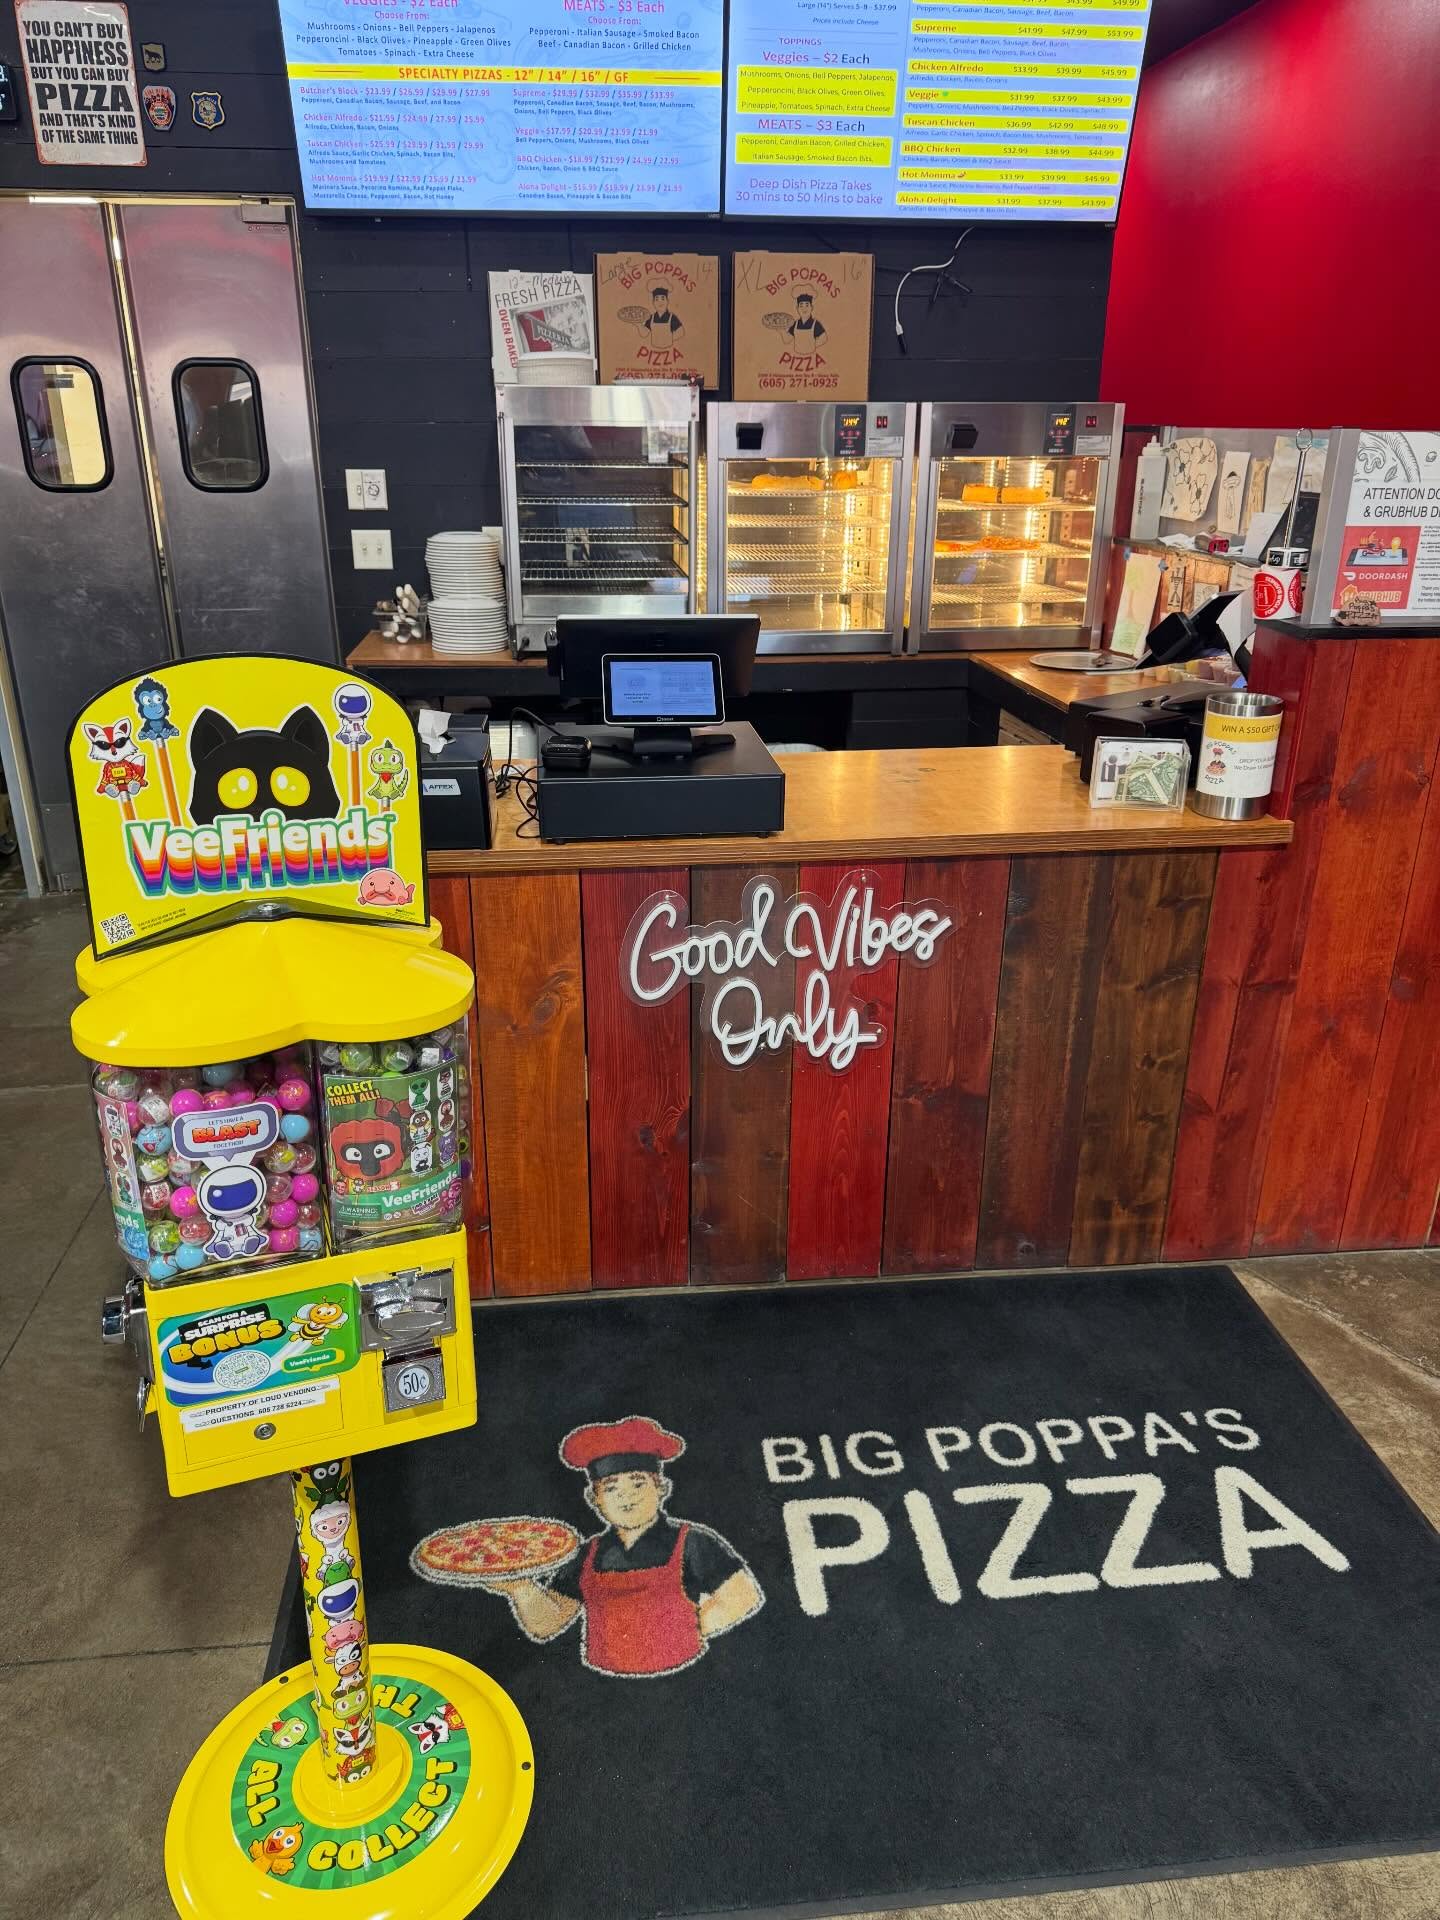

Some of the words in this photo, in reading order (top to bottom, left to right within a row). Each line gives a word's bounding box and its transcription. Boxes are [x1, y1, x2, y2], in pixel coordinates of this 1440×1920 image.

[564, 0, 605, 11] MEATS
[618, 1, 632, 12] $3
[637, 1, 665, 13] Each
[375, 11, 402, 20] Choose
[406, 12, 430, 20] From:
[588, 16, 617, 25] Choose
[619, 17, 641, 25] From:
[23, 21, 50, 36] YOU
[54, 22, 93, 38] CAN'T
[97, 23, 123, 39] BUY
[307, 22, 355, 31] Mushrooms
[363, 24, 391, 32] Onions
[399, 24, 415, 32] Bell
[417, 25, 448, 34] Peppers
[456, 26, 496, 34] Jalapenos
[529, 28, 570, 36] Pepperoni
[577, 29, 602, 37] Italian
[604, 30, 636, 39] Sausage
[644, 30, 674, 38] Smoked
[676, 31, 700, 39] Bacon
[915, 23, 957, 34] Supreme
[296, 35, 349, 44] Pepperoncini
[357, 36, 379, 44] Black
[381, 36, 406, 45] Olives
[413, 37, 453, 47] Pineapple
[460, 38, 485, 46] Green
[486, 39, 511, 47] Olives
[538, 40, 556, 48] Beef
[563, 40, 600, 49] Canadian
[633, 42, 659, 51] Grilled
[661, 43, 691, 51] Chicken
[779, 37, 822, 46] TOPPINGS
[26, 38, 129, 67] HAPPINESS
[338, 48, 377, 56] Tomatoes
[384, 49, 416, 58] Spinach
[423, 49, 444, 58] Extra
[446, 50, 474, 58] Cheese
[762, 51, 809, 64] Veggies
[823, 52, 838, 63] $2
[841, 53, 870, 65] Each
[31, 66, 55, 81] BUT
[57, 67, 78, 81] YOU
[81, 68, 104, 82] CAN
[107, 69, 129, 82] BUY
[911, 62, 948, 72] Chicken
[950, 63, 984, 72] Alfredo
[399, 68, 458, 79] SPECIALTY
[463, 69, 503, 80] PIZZAS
[514, 70, 534, 80] 12"
[548, 70, 567, 81] 14"
[581, 71, 601, 82] 16"
[614, 72, 629, 83] GF
[35, 82, 134, 112] PIZZA
[513, 88, 546, 99] Supreme
[841, 88, 862, 96] Green
[909, 90, 939, 101] Veggie
[39, 113, 63, 127] AND
[66, 113, 106, 128] THAT'S
[109, 114, 136, 128] KIND
[303, 113, 332, 121] Chicken
[907, 118, 939, 126] Tuscan
[940, 118, 975, 127] Chicken
[758, 119, 801, 130] MEATS
[816, 119, 832, 131] $3
[836, 120, 865, 132] Each
[42, 130, 55, 143] OF
[57, 130, 76, 144] THE
[77, 130, 107, 144] SAME
[108, 131, 138, 145] THING
[904, 144, 924, 154] BBQ
[926, 145, 961, 153] Chicken
[807, 154, 835, 162] Smoked
[902, 170, 919, 179] Hot
[750, 178, 779, 190] Deep
[782, 178, 807, 190] Dish
[810, 179, 838, 190] Pizza
[840, 180, 872, 191] Takes
[736, 191, 751, 202] 30
[753, 192, 780, 202] mins
[783, 192, 794, 202] to
[797, 193, 811, 203] 50
[813, 193, 840, 204] Mins
[842, 194, 854, 204] to
[856, 194, 883, 205] bake
[900, 195, 924, 203] Aloha
[925, 196, 957, 205] Delight
[620, 268, 642, 290] BIG
[737, 259, 769, 292] XL
[765, 273, 788, 297] BIG
[495, 288, 538, 308] FRESH
[542, 279, 582, 300] PIZZA
[498, 309, 513, 335] OVEN
[504, 337, 519, 369] BAKED
[636, 345, 684, 366] PIZZA
[778, 351, 827, 372] PIZZA
[759, 378, 786, 390] (605)
[789, 377, 839, 389] 271-0925
[1363, 487, 1425, 500] ATTENTION
[1363, 506, 1371, 517] &
[1374, 506, 1428, 518] GRUBHUB
[1431, 507, 1440, 518] D
[1359, 572, 1408, 581] DOORDASH
[1264, 607, 1275, 616] FOR
[1221, 724, 1237, 733] WIN
[1247, 726, 1261, 734] $50
[126, 810, 396, 896] VeeFriends
[630, 884, 778, 1001] Good
[784, 885, 953, 972] Vibes
[710, 970, 879, 1070] Only
[326, 1080, 374, 1097] COLLECT
[328, 1095, 357, 1107] THEM
[358, 1091, 382, 1103] ALL!
[191, 1119, 262, 1144] BLAST
[381, 1170, 459, 1209] VeeFriends
[185, 1311, 267, 1342] SURPRISE
[198, 1317, 221, 1328] SCAN
[221, 1313, 238, 1324] FOR
[168, 1319, 284, 1364] BONUS
[289, 1353, 331, 1368] VeeFriends
[205, 1402, 247, 1416] PROPERTY
[248, 1398, 260, 1407] OF
[260, 1393, 283, 1405] LOUD
[283, 1386, 318, 1400] VENDING
[210, 1410, 256, 1425] QUESTIONS
[761, 1430, 904, 1484] BIG
[925, 1408, 1261, 1473] POPPA'S
[782, 1464, 1352, 1617] PIZZA
[372, 1683, 421, 1719] TH
[245, 1759, 283, 1829] ALL
[306, 1757, 457, 1872] COLLECT
